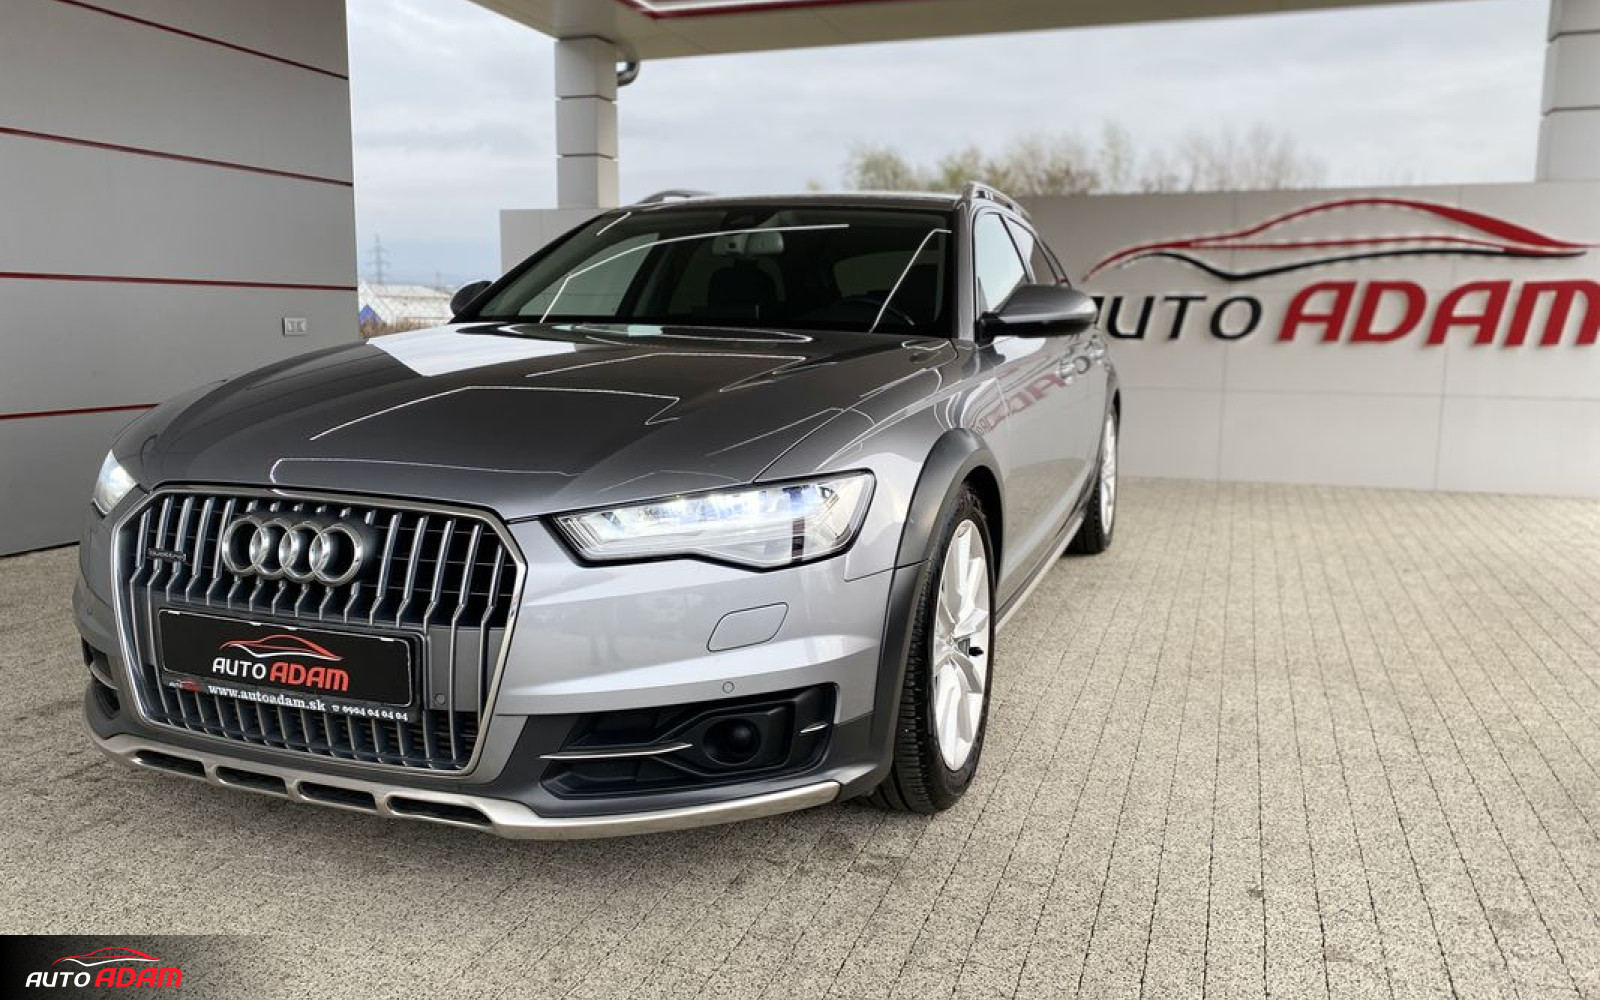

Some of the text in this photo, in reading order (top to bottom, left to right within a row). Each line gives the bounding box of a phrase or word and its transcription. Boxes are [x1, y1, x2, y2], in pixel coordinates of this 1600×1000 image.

[1090, 280, 1600, 348] UTO ADAM
[212, 656, 349, 692] AUTO ADAM
[207, 684, 326, 712] www.autoadam.sk
